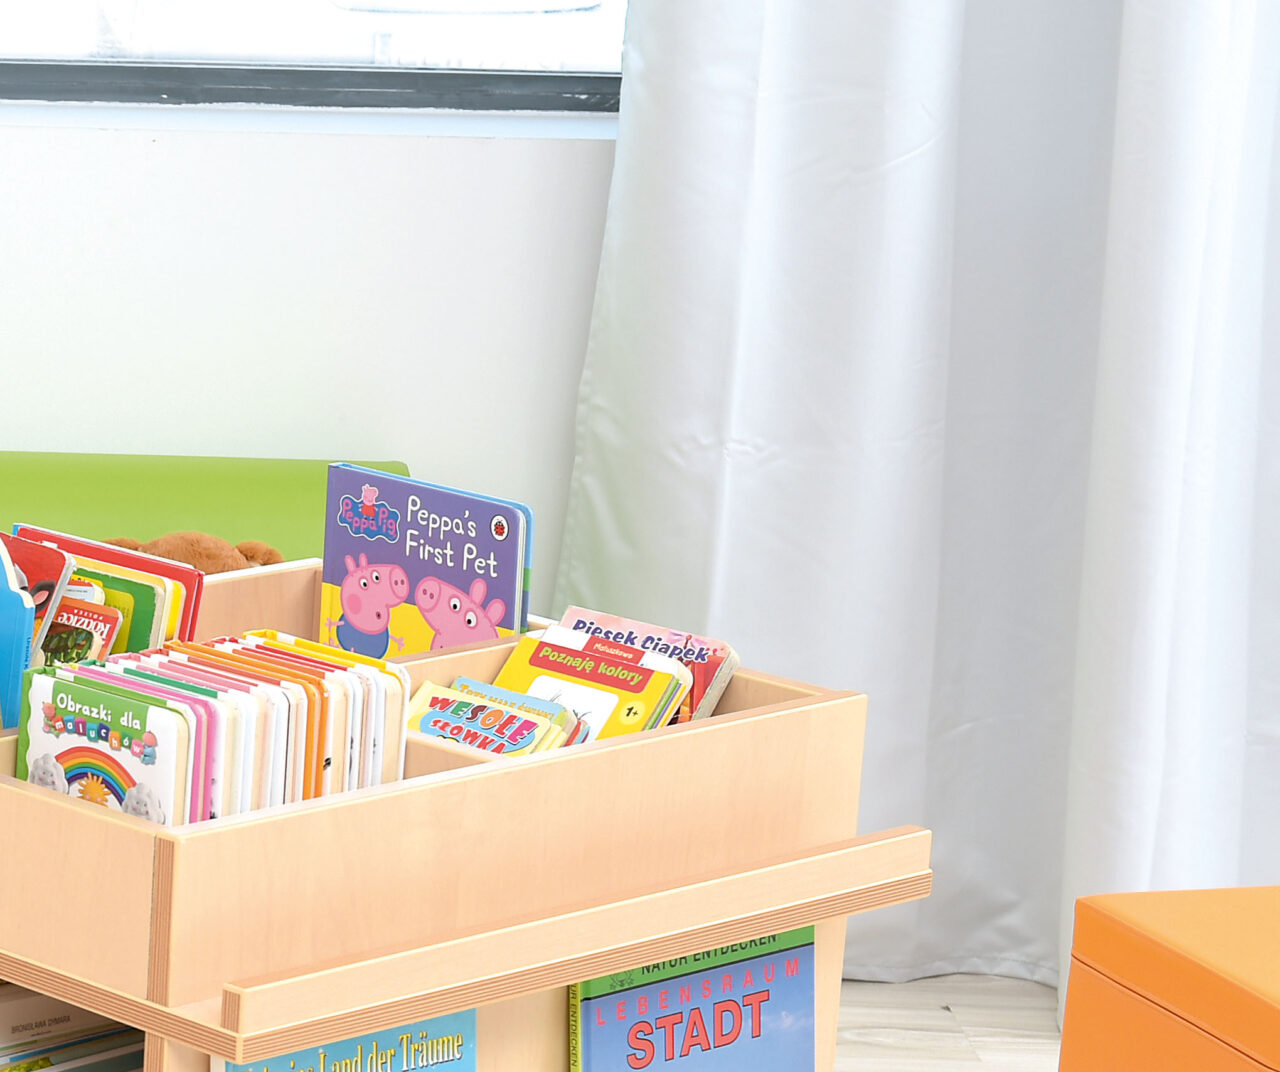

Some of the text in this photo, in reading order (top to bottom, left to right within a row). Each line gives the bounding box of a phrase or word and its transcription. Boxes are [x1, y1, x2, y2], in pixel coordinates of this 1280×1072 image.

[342, 499, 398, 537] Peppa Pig
[407, 495, 477, 540] Peppa's
[406, 529, 498, 578] First Pet
[572, 619, 710, 664] Piesek Ciapek
[539, 646, 643, 686] Poznaję kolory
[56, 693, 142, 731] Obrazki dla
[428, 696, 539, 745] WESOŁE
[626, 706, 639, 718] 1+
[54, 718, 143, 754] maluchów
[596, 957, 800, 1025] LEBENSRAUM
[626, 989, 771, 1070] STADT
[399, 1031, 463, 1072] Träume
